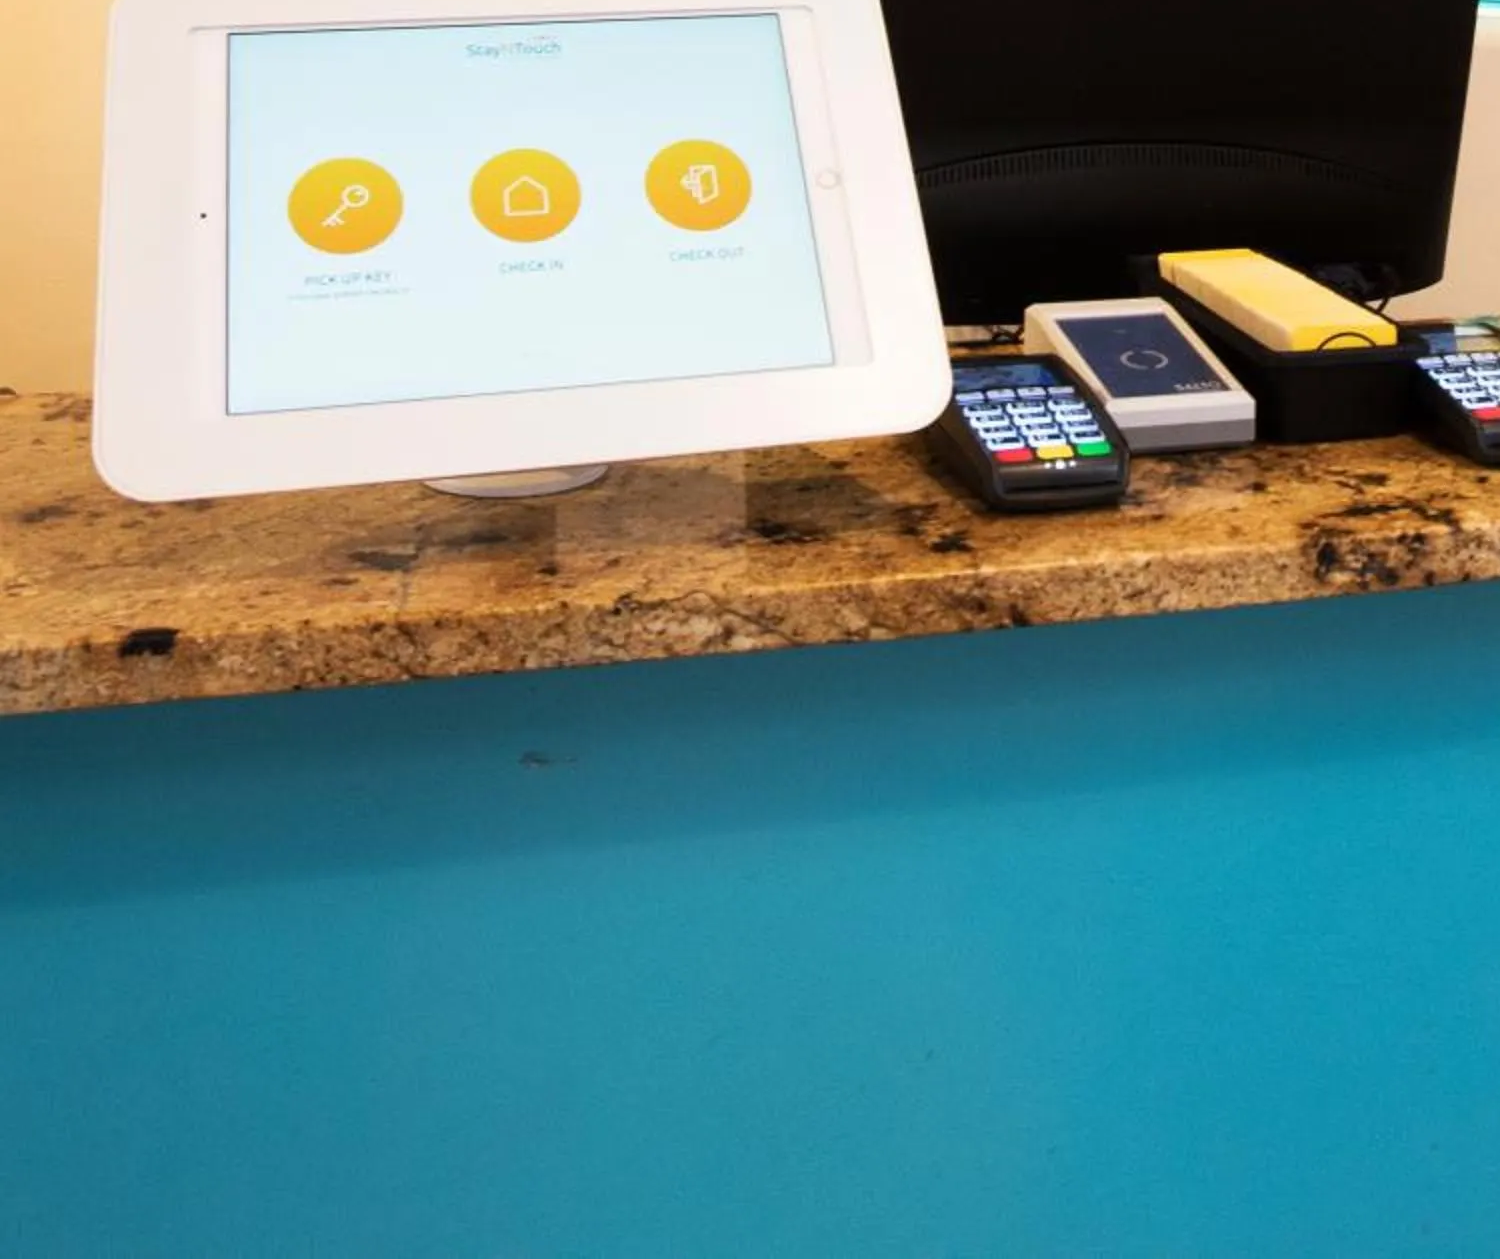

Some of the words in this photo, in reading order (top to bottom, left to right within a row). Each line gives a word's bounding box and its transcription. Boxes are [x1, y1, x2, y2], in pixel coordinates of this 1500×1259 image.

[668, 249, 714, 262] CHECK
[716, 246, 745, 260] OUT
[498, 259, 547, 275] CHECK
[549, 258, 565, 271] IN
